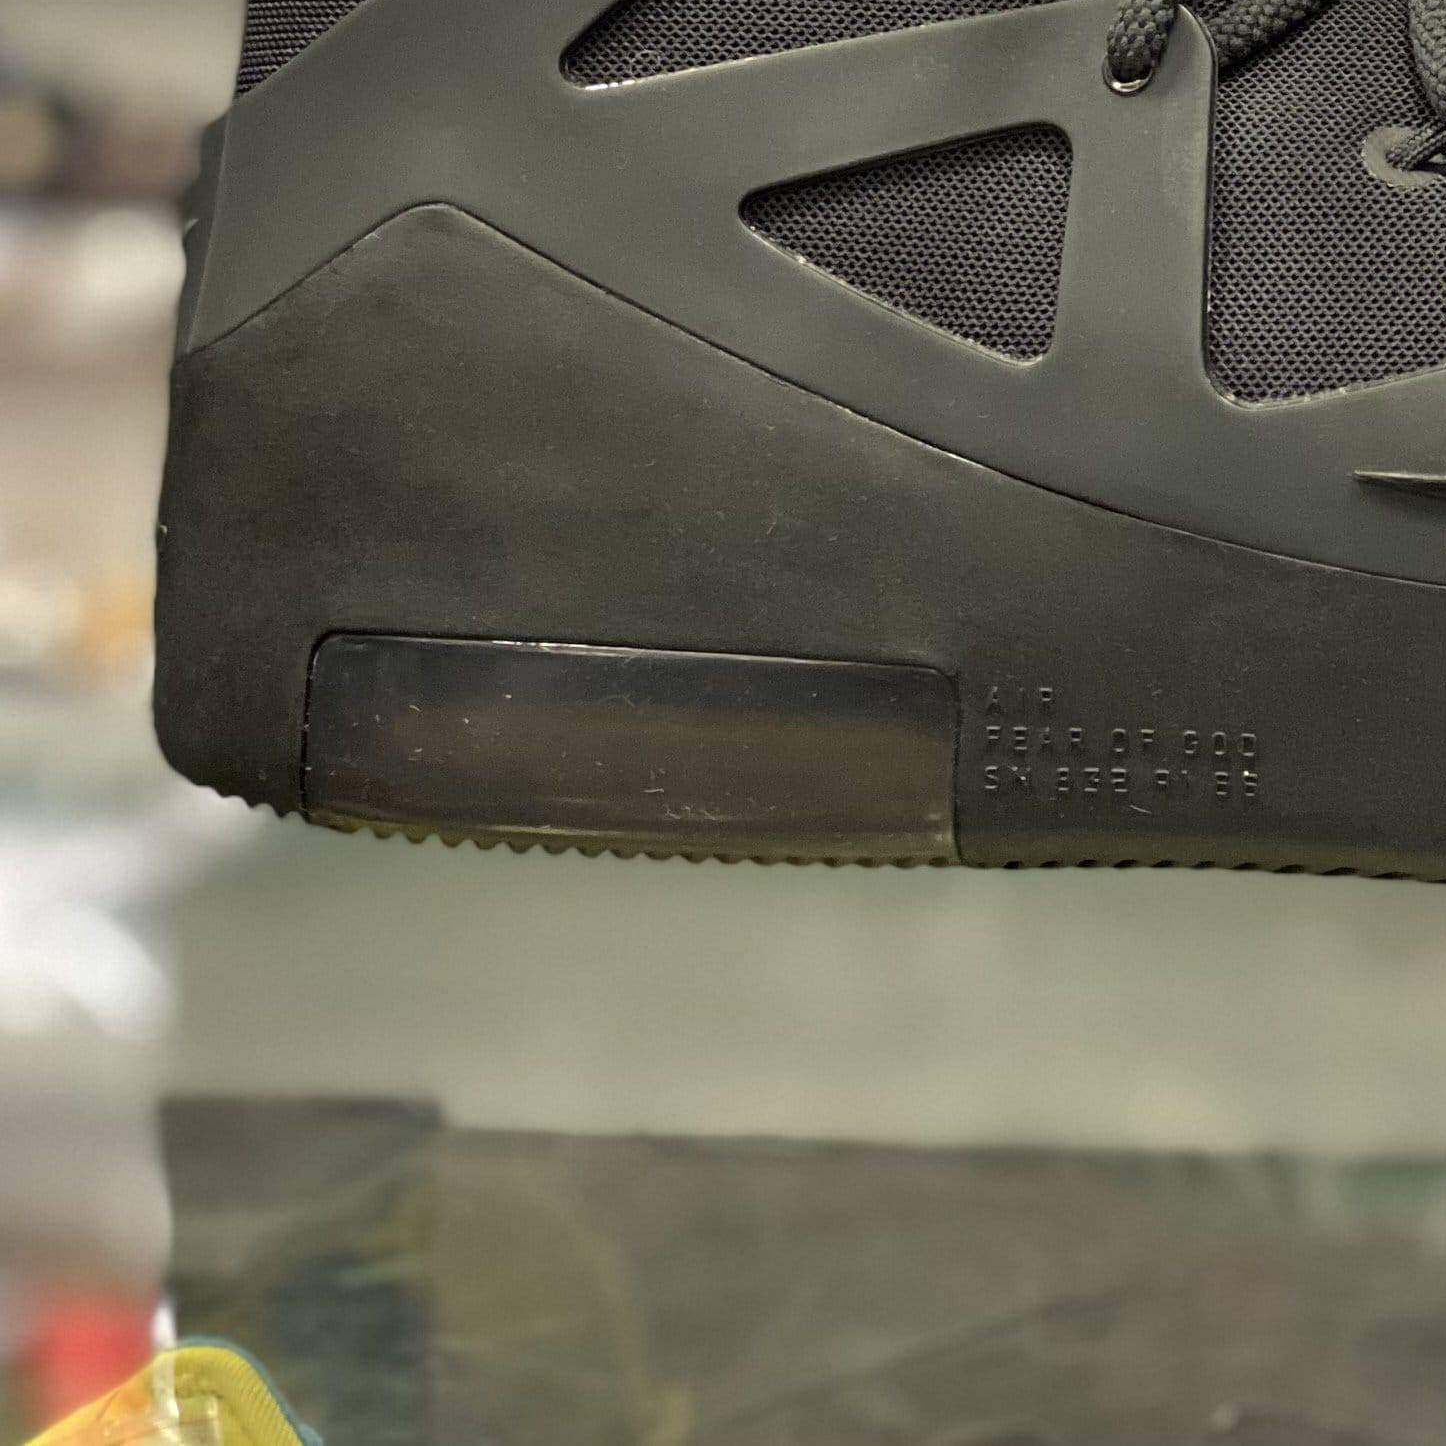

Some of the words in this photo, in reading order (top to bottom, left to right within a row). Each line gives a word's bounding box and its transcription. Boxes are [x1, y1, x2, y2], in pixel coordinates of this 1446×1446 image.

[984, 685, 1055, 711] AIR
[985, 725, 1084, 753] FEAR
[1111, 727, 1156, 755] OF
[1182, 729, 1256, 758] GOD
[984, 764, 1032, 792] SN
